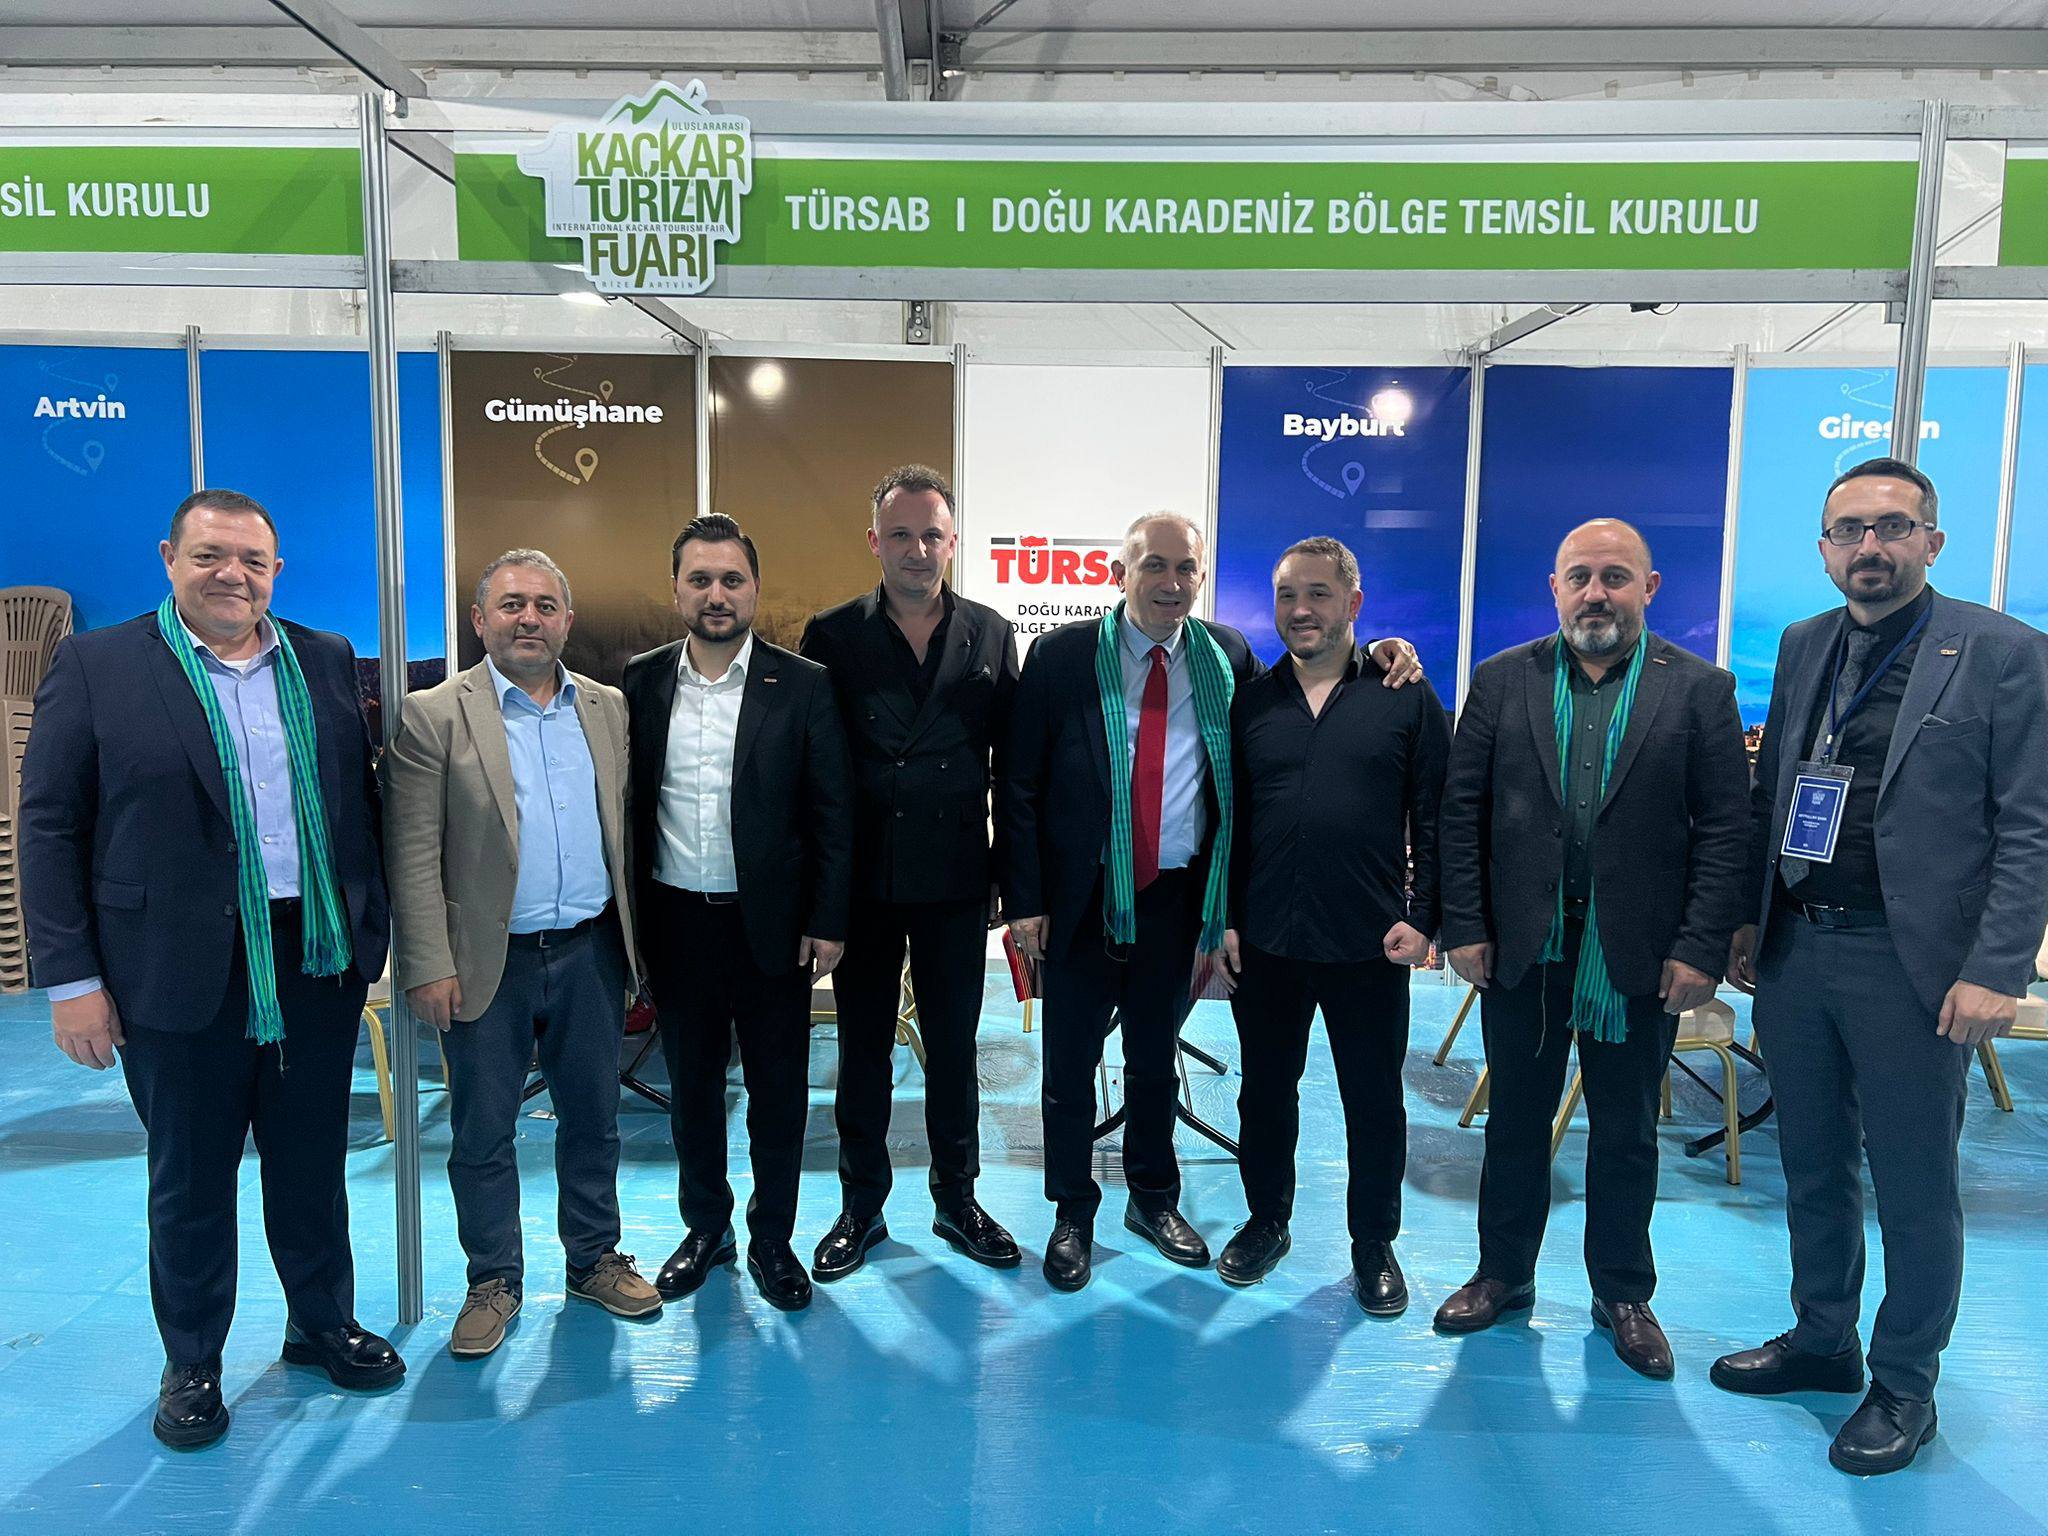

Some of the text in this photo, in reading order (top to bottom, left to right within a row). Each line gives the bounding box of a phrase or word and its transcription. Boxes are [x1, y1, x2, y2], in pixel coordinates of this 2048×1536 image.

[671, 121, 744, 131] ULUSLARARASI
[67, 182, 210, 217] KURULU
[574, 171, 734, 238] TURİZM
[785, 188, 930, 232] TÜRSAB
[992, 188, 1091, 234] DOĞU
[1105, 192, 1313, 234] KARADENİZ
[1327, 191, 1447, 234] BÖLGE
[1458, 192, 1595, 234] TEMSİL
[1609, 198, 1759, 234] KURULU
[552, 223, 622, 232] INTERNATIONAL
[664, 224, 703, 232] TOURISM
[704, 224, 725, 232] FAIR
[589, 234, 708, 288] FUARI
[33, 394, 126, 418] Artvin
[484, 398, 663, 429] Gümüşhane
[1283, 413, 1405, 441] Bayburt
[1818, 413, 1940, 439] Giresn
[990, 548, 1119, 585] TÜRS
[1017, 602, 1060, 616] DOĞU
